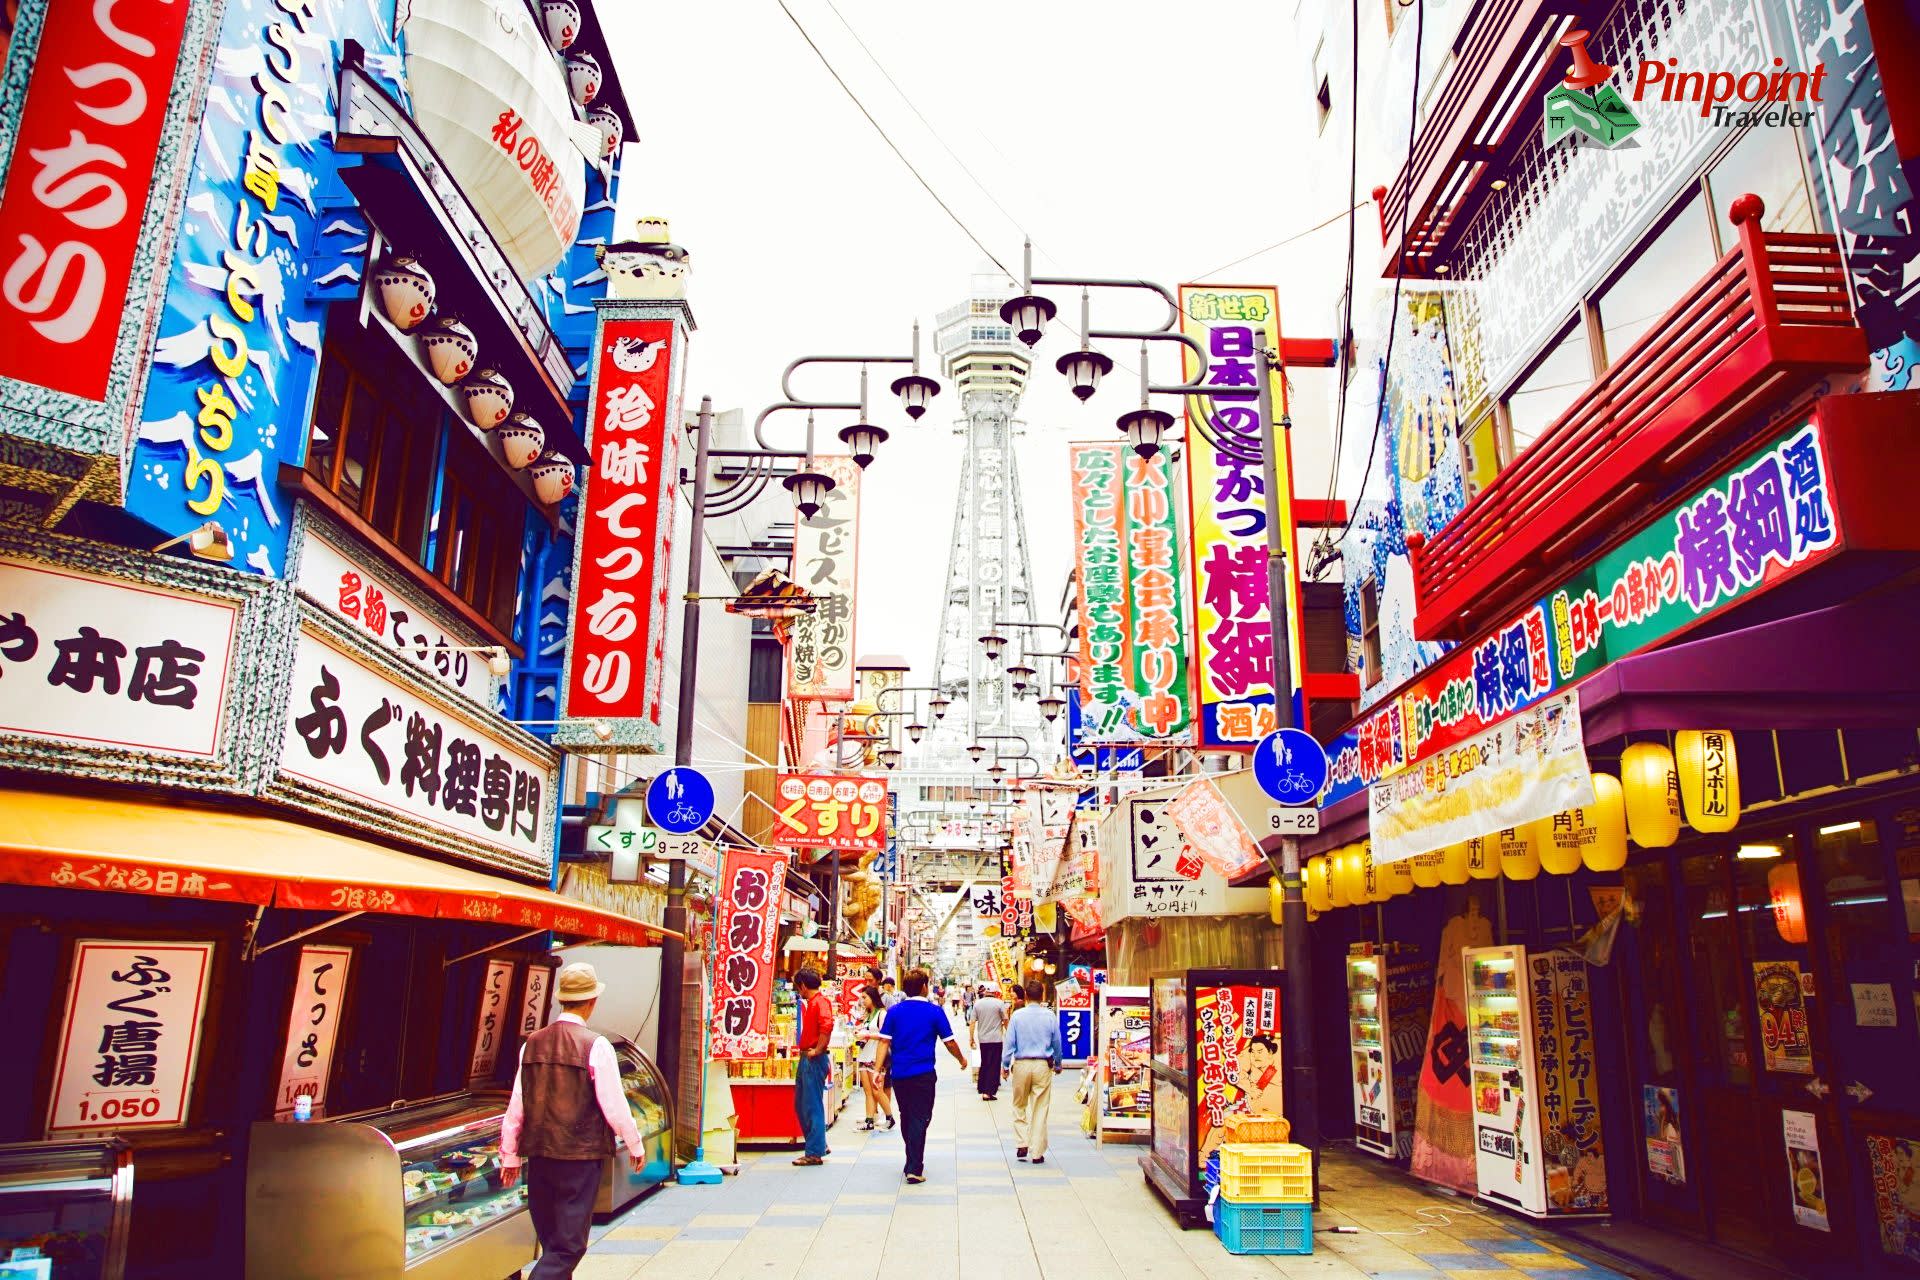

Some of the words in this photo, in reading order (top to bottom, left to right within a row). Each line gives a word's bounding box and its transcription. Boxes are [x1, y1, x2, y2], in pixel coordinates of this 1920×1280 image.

[1190, 293, 1269, 321] 新世界
[582, 383, 657, 704] 珍味てっちり
[1553, 594, 1573, 675] 新世界
[1571, 557, 1678, 652] 日本一の串かつ
[1678, 457, 1792, 607] 横綱
[1782, 432, 1831, 553] 酒処
[339, 570, 468, 688] 名物てっちり
[818, 592, 851, 668] 串かつ
[1128, 454, 1179, 734] 大小宴会承り中
[1203, 544, 1275, 696] 横綱
[1416, 681, 1473, 741] 日本一の串かつ
[1473, 623, 1531, 719] 横綱
[1527, 610, 1548, 692] 酒処
[295, 664, 541, 843] ふぐ料理専門
[1704, 735, 1725, 814] 角ハイボール
[598, 829, 657, 849] くすり
[781, 799, 880, 837] くすり
[1553, 811, 1572, 831] 角
[51, 862, 232, 897] ふぐなら日本一
[330, 886, 395, 908] づぼらや
[723, 869, 767, 1036] おみやげ
[93, 954, 172, 1088] ふぐ唐揚
[297, 962, 333, 1068] てっさ
[482, 969, 504, 1052] てっちり
[1061, 997, 1089, 1007] レストラン
[1066, 1011, 1081, 1056] スター
[1245, 999, 1255, 1037] 大阪名物
[1565, 1001, 1599, 1149] ビアガーデン
